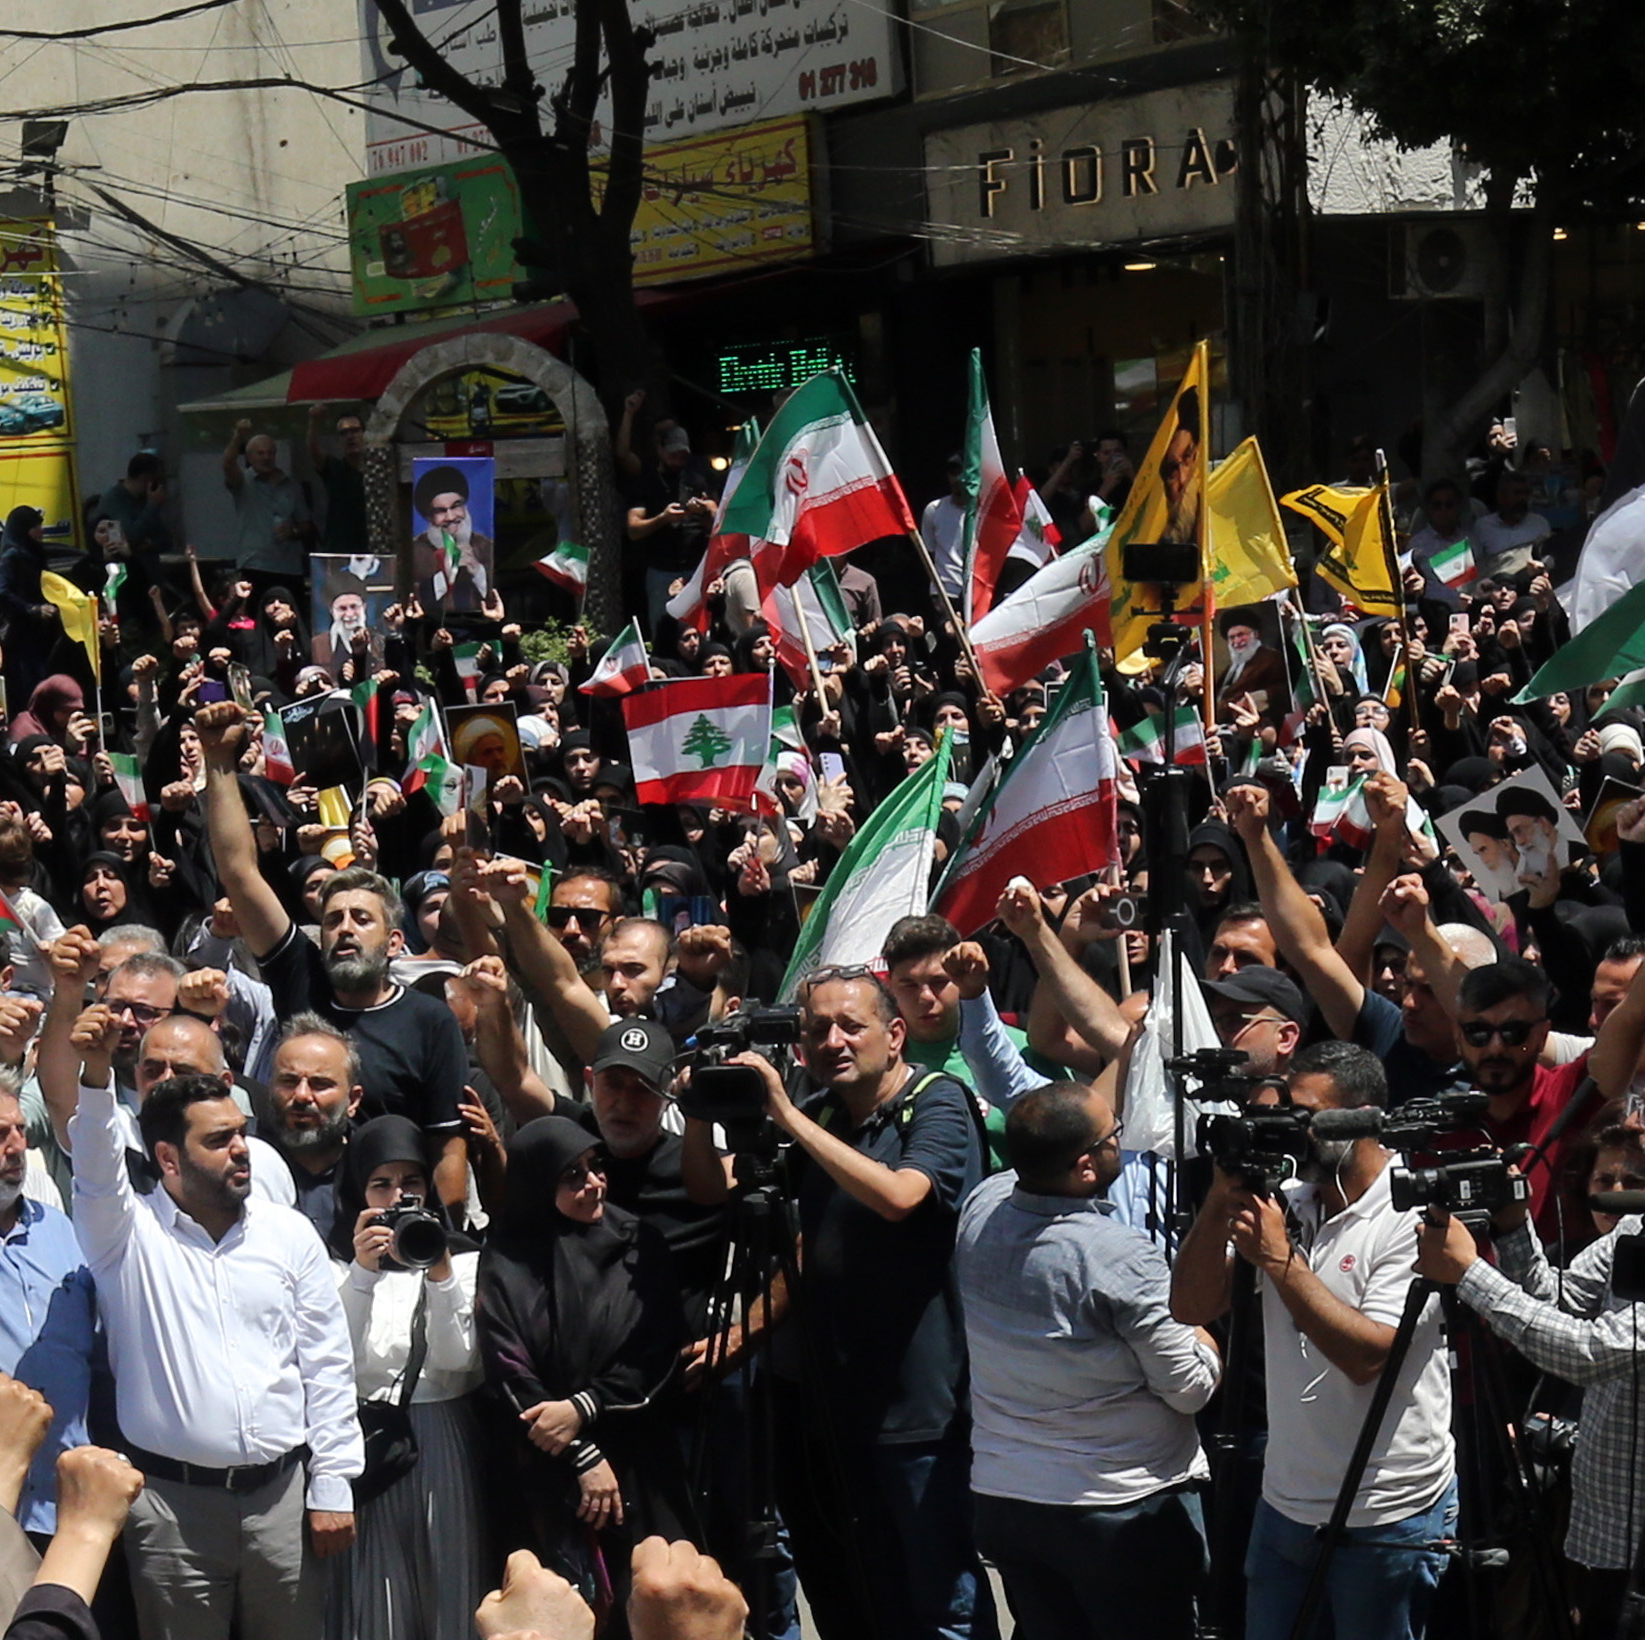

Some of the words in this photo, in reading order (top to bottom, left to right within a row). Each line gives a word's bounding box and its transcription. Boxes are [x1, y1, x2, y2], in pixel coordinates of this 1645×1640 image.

[731, 31, 758, 61] كاملة
[760, 27, 800, 58] متحركة
[803, 12, 848, 47] تركيبات
[798, 68, 816, 101] 01
[820, 63, 847, 97] 277
